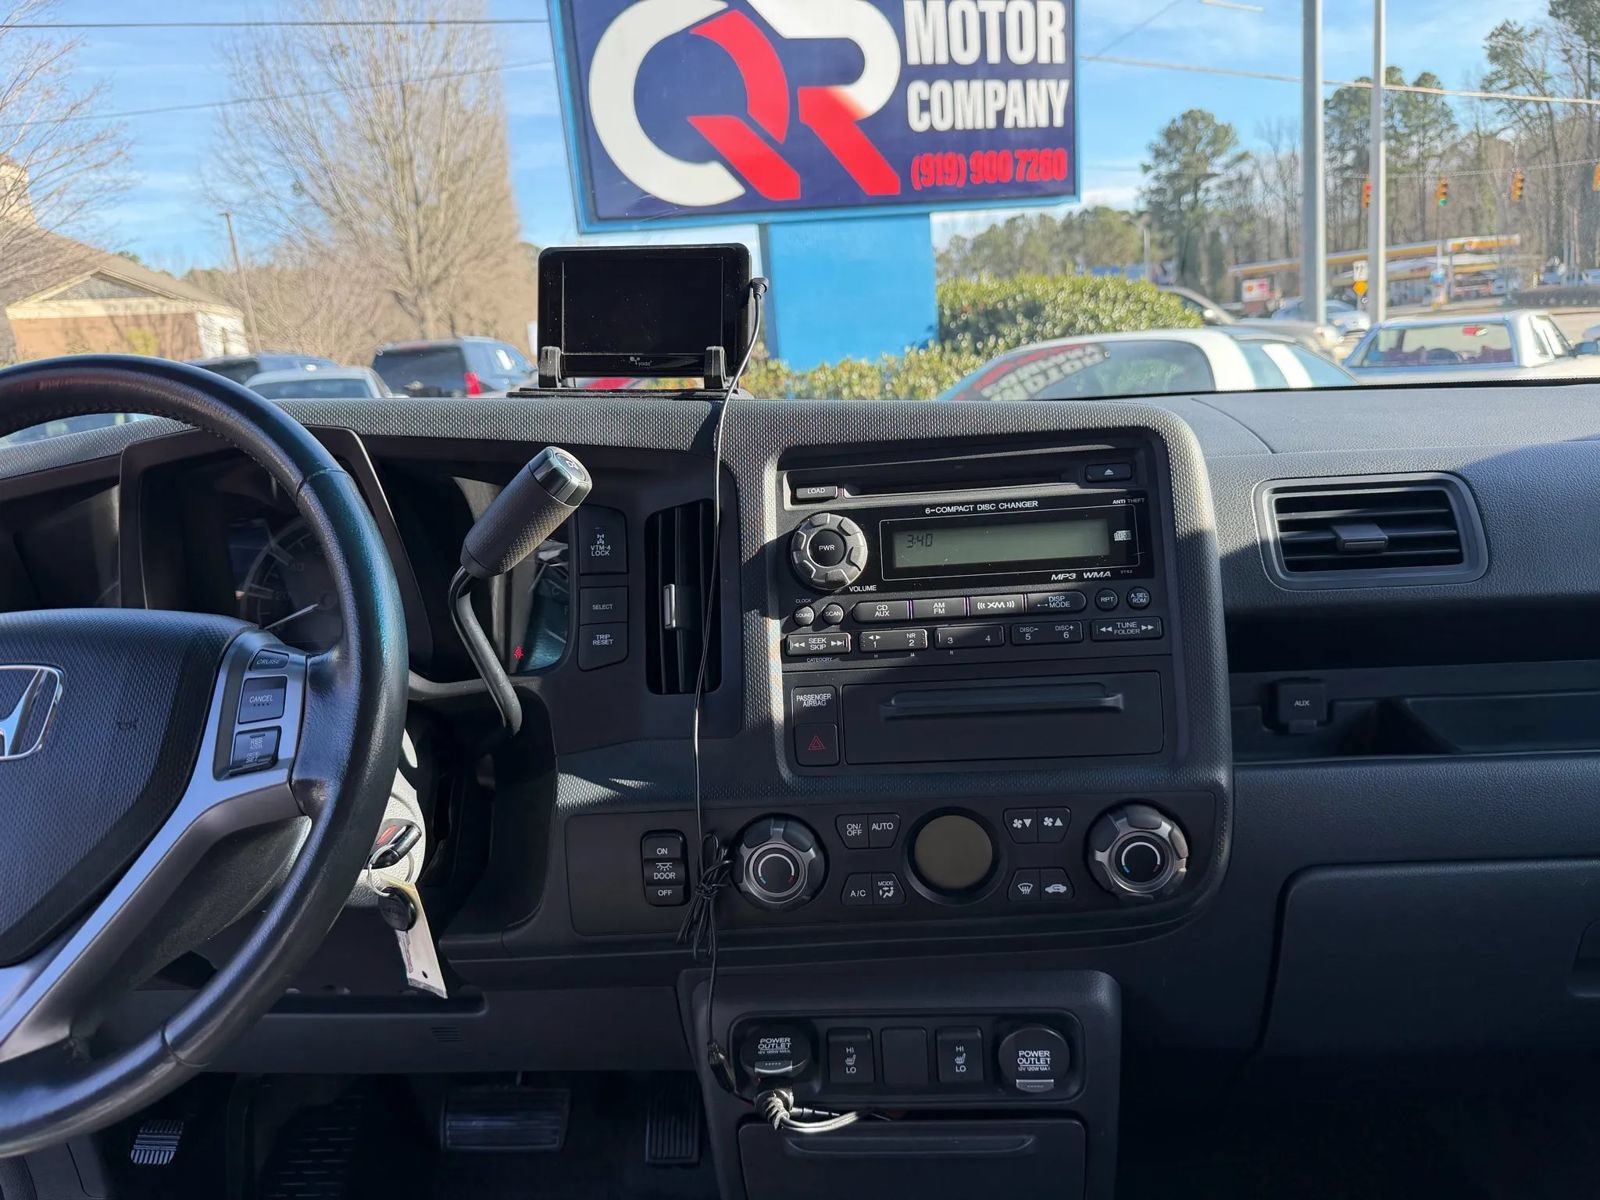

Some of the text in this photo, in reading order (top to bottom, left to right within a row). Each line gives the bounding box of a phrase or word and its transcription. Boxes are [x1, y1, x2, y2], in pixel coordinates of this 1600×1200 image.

[903, 0, 1066, 65] MOTOR
[907, 79, 1070, 132] COMPANY
[911, 152, 967, 190] (919)
[969, 150, 1013, 184] 900
[807, 487, 826, 495] LOAD
[925, 500, 1038, 514] 6-COMPACT DISC CHANGER
[906, 533, 934, 548] 3:40
[1051, 571, 1076, 581] MP3
[1083, 570, 1112, 579] WMA
[848, 584, 877, 592] VOLUME
[249, 695, 273, 703] CANCEL
[796, 692, 832, 702] PASSENGER
[871, 822, 894, 830] AUTO
[653, 872, 676, 880] DOOR
[1017, 1057, 1051, 1065] OUTLET
